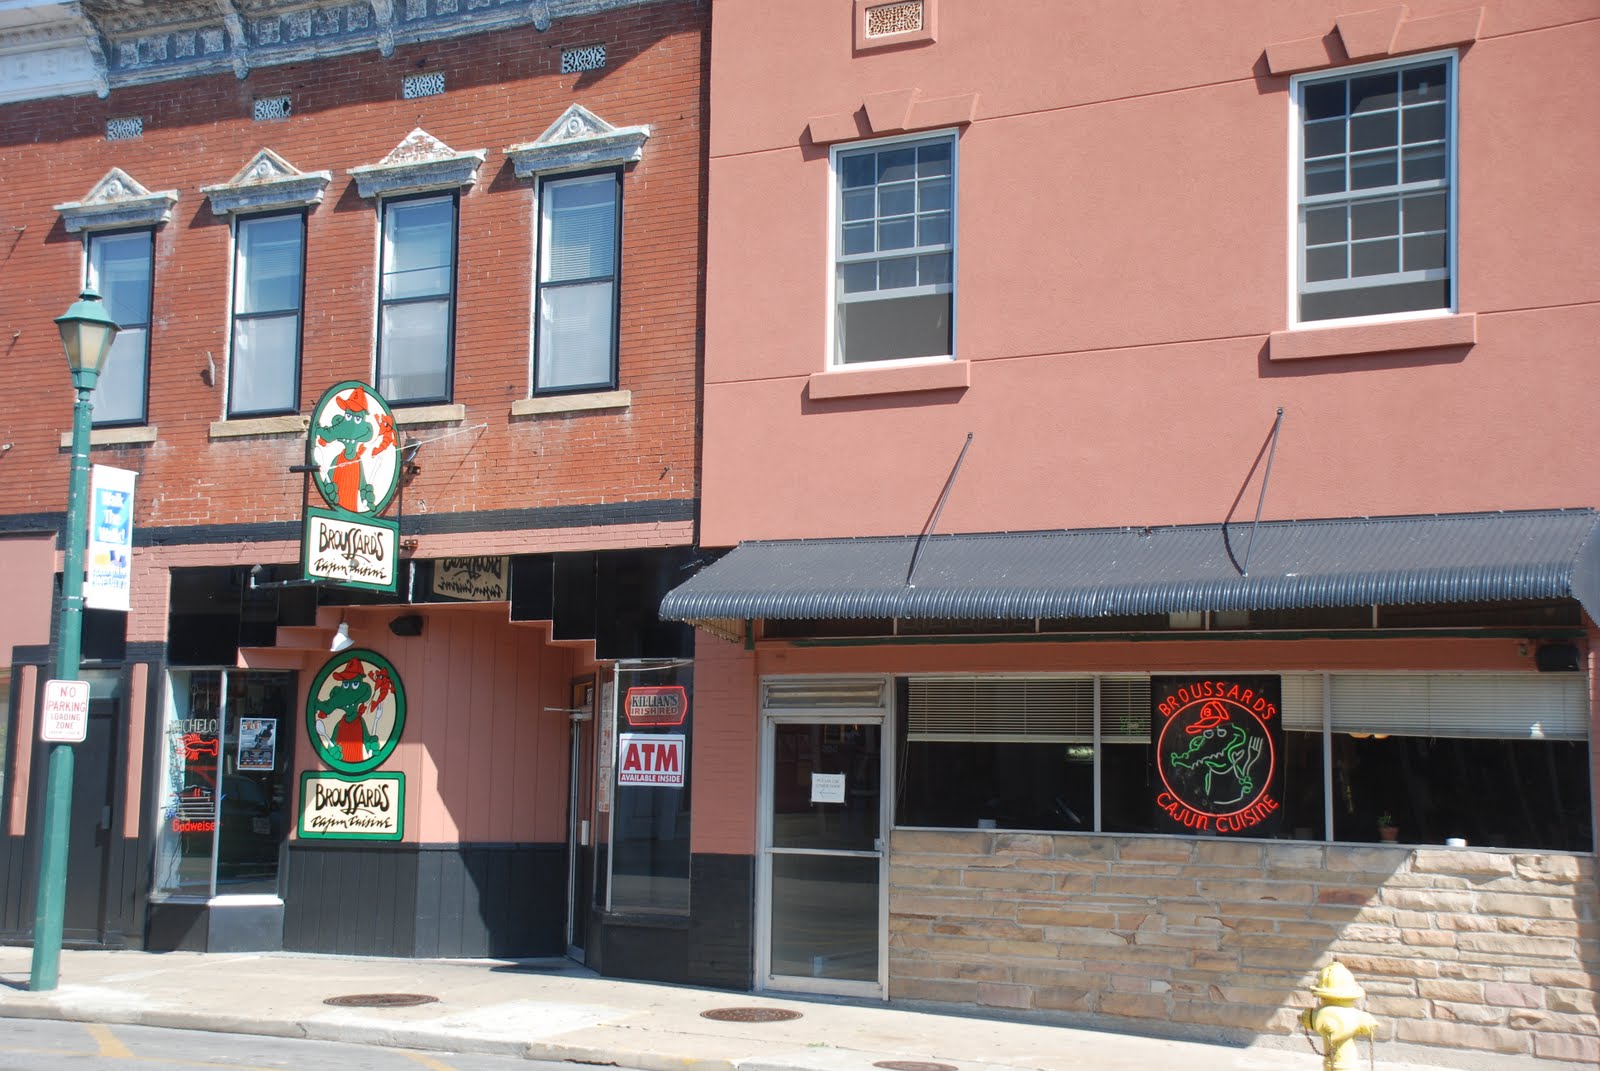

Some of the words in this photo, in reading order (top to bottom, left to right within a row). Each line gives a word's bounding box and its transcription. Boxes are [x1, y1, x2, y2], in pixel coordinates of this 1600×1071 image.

[60, 686, 76, 698] NO
[48, 700, 87, 712] PARKING
[631, 695, 678, 707] KILLIAN'S
[1158, 681, 1277, 720] BROUSSARD'S
[50, 713, 81, 721] LOADING
[631, 707, 657, 716] IRISH
[659, 706, 678, 715] RED
[55, 721, 74, 730] ZONE
[623, 743, 679, 772] ATM
[621, 773, 656, 783] AVAILABLE
[657, 774, 681, 783] INSIDE
[315, 783, 389, 815] BROUSSARD'S
[1157, 792, 1209, 831] CAJUN
[1216, 794, 1280, 833] CUISINE
[311, 815, 348, 835] Cajun
